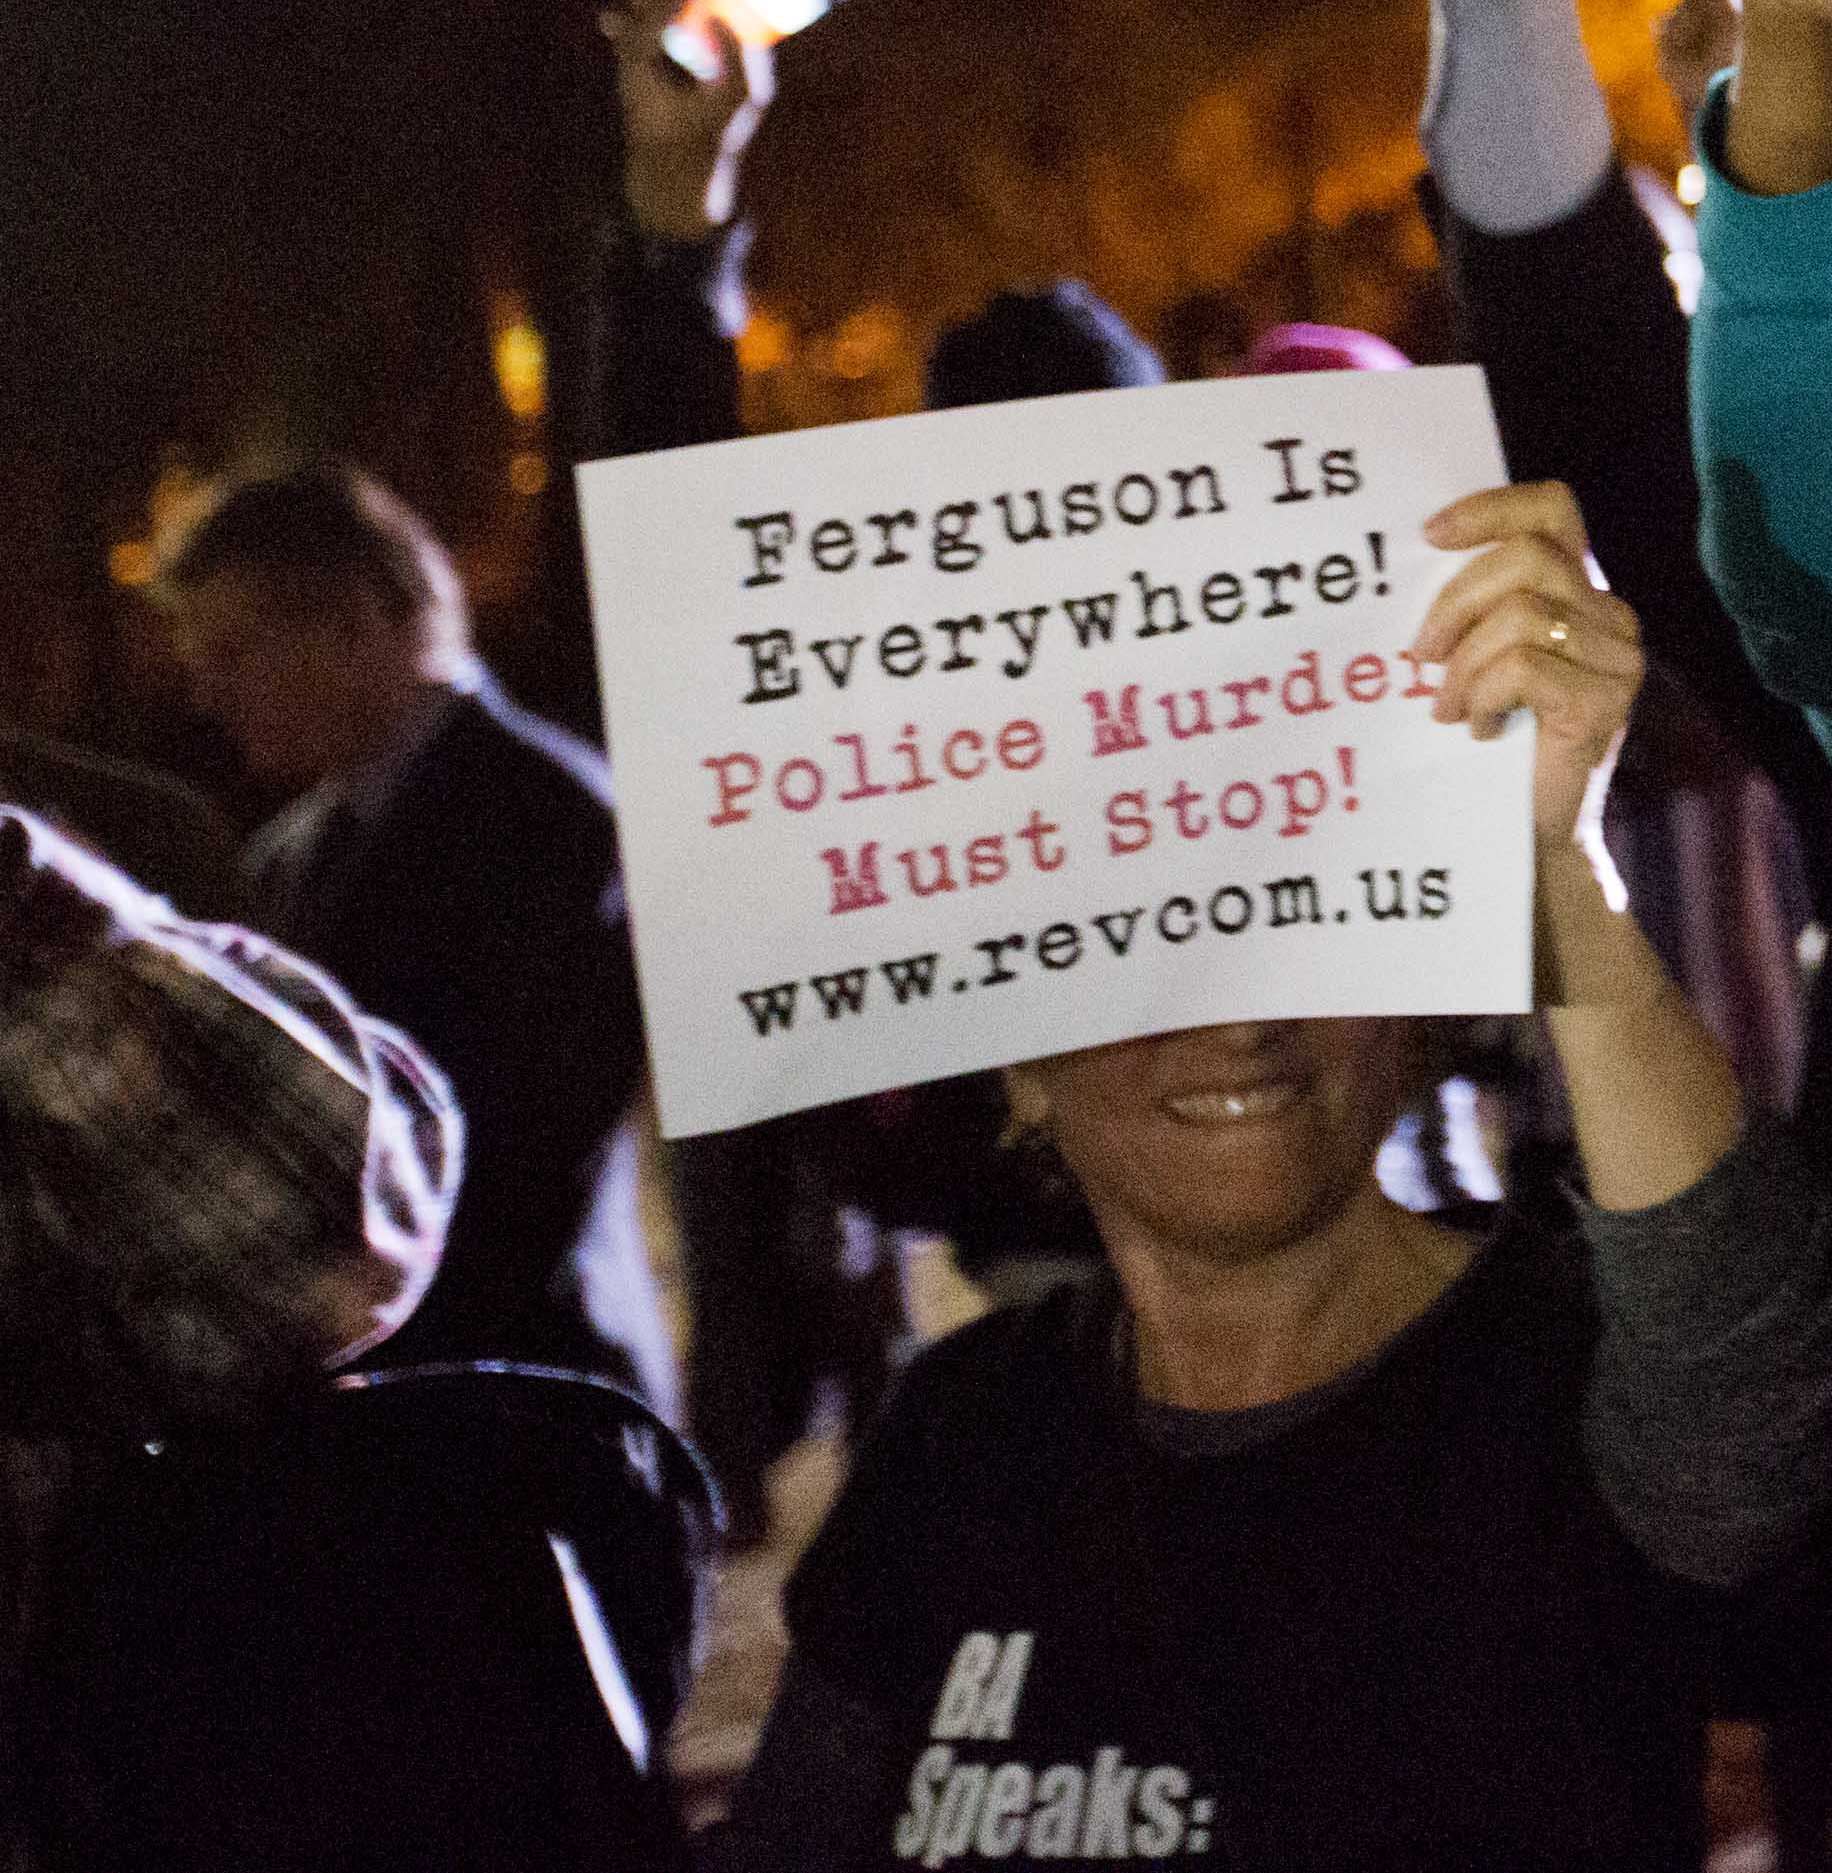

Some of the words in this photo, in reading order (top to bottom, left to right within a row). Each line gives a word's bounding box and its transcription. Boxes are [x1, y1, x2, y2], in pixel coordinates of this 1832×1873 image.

[735, 464, 1226, 588] Ferguson
[1264, 437, 1361, 504] Is
[735, 531, 1389, 705] Everywhere!
[702, 719, 1044, 828] Police
[821, 811, 1065, 915] Must
[1104, 746, 1359, 857] Stop!
[738, 867, 1453, 1037] www.revcom.us
[895, 1744, 1217, 1869] Speaks:
